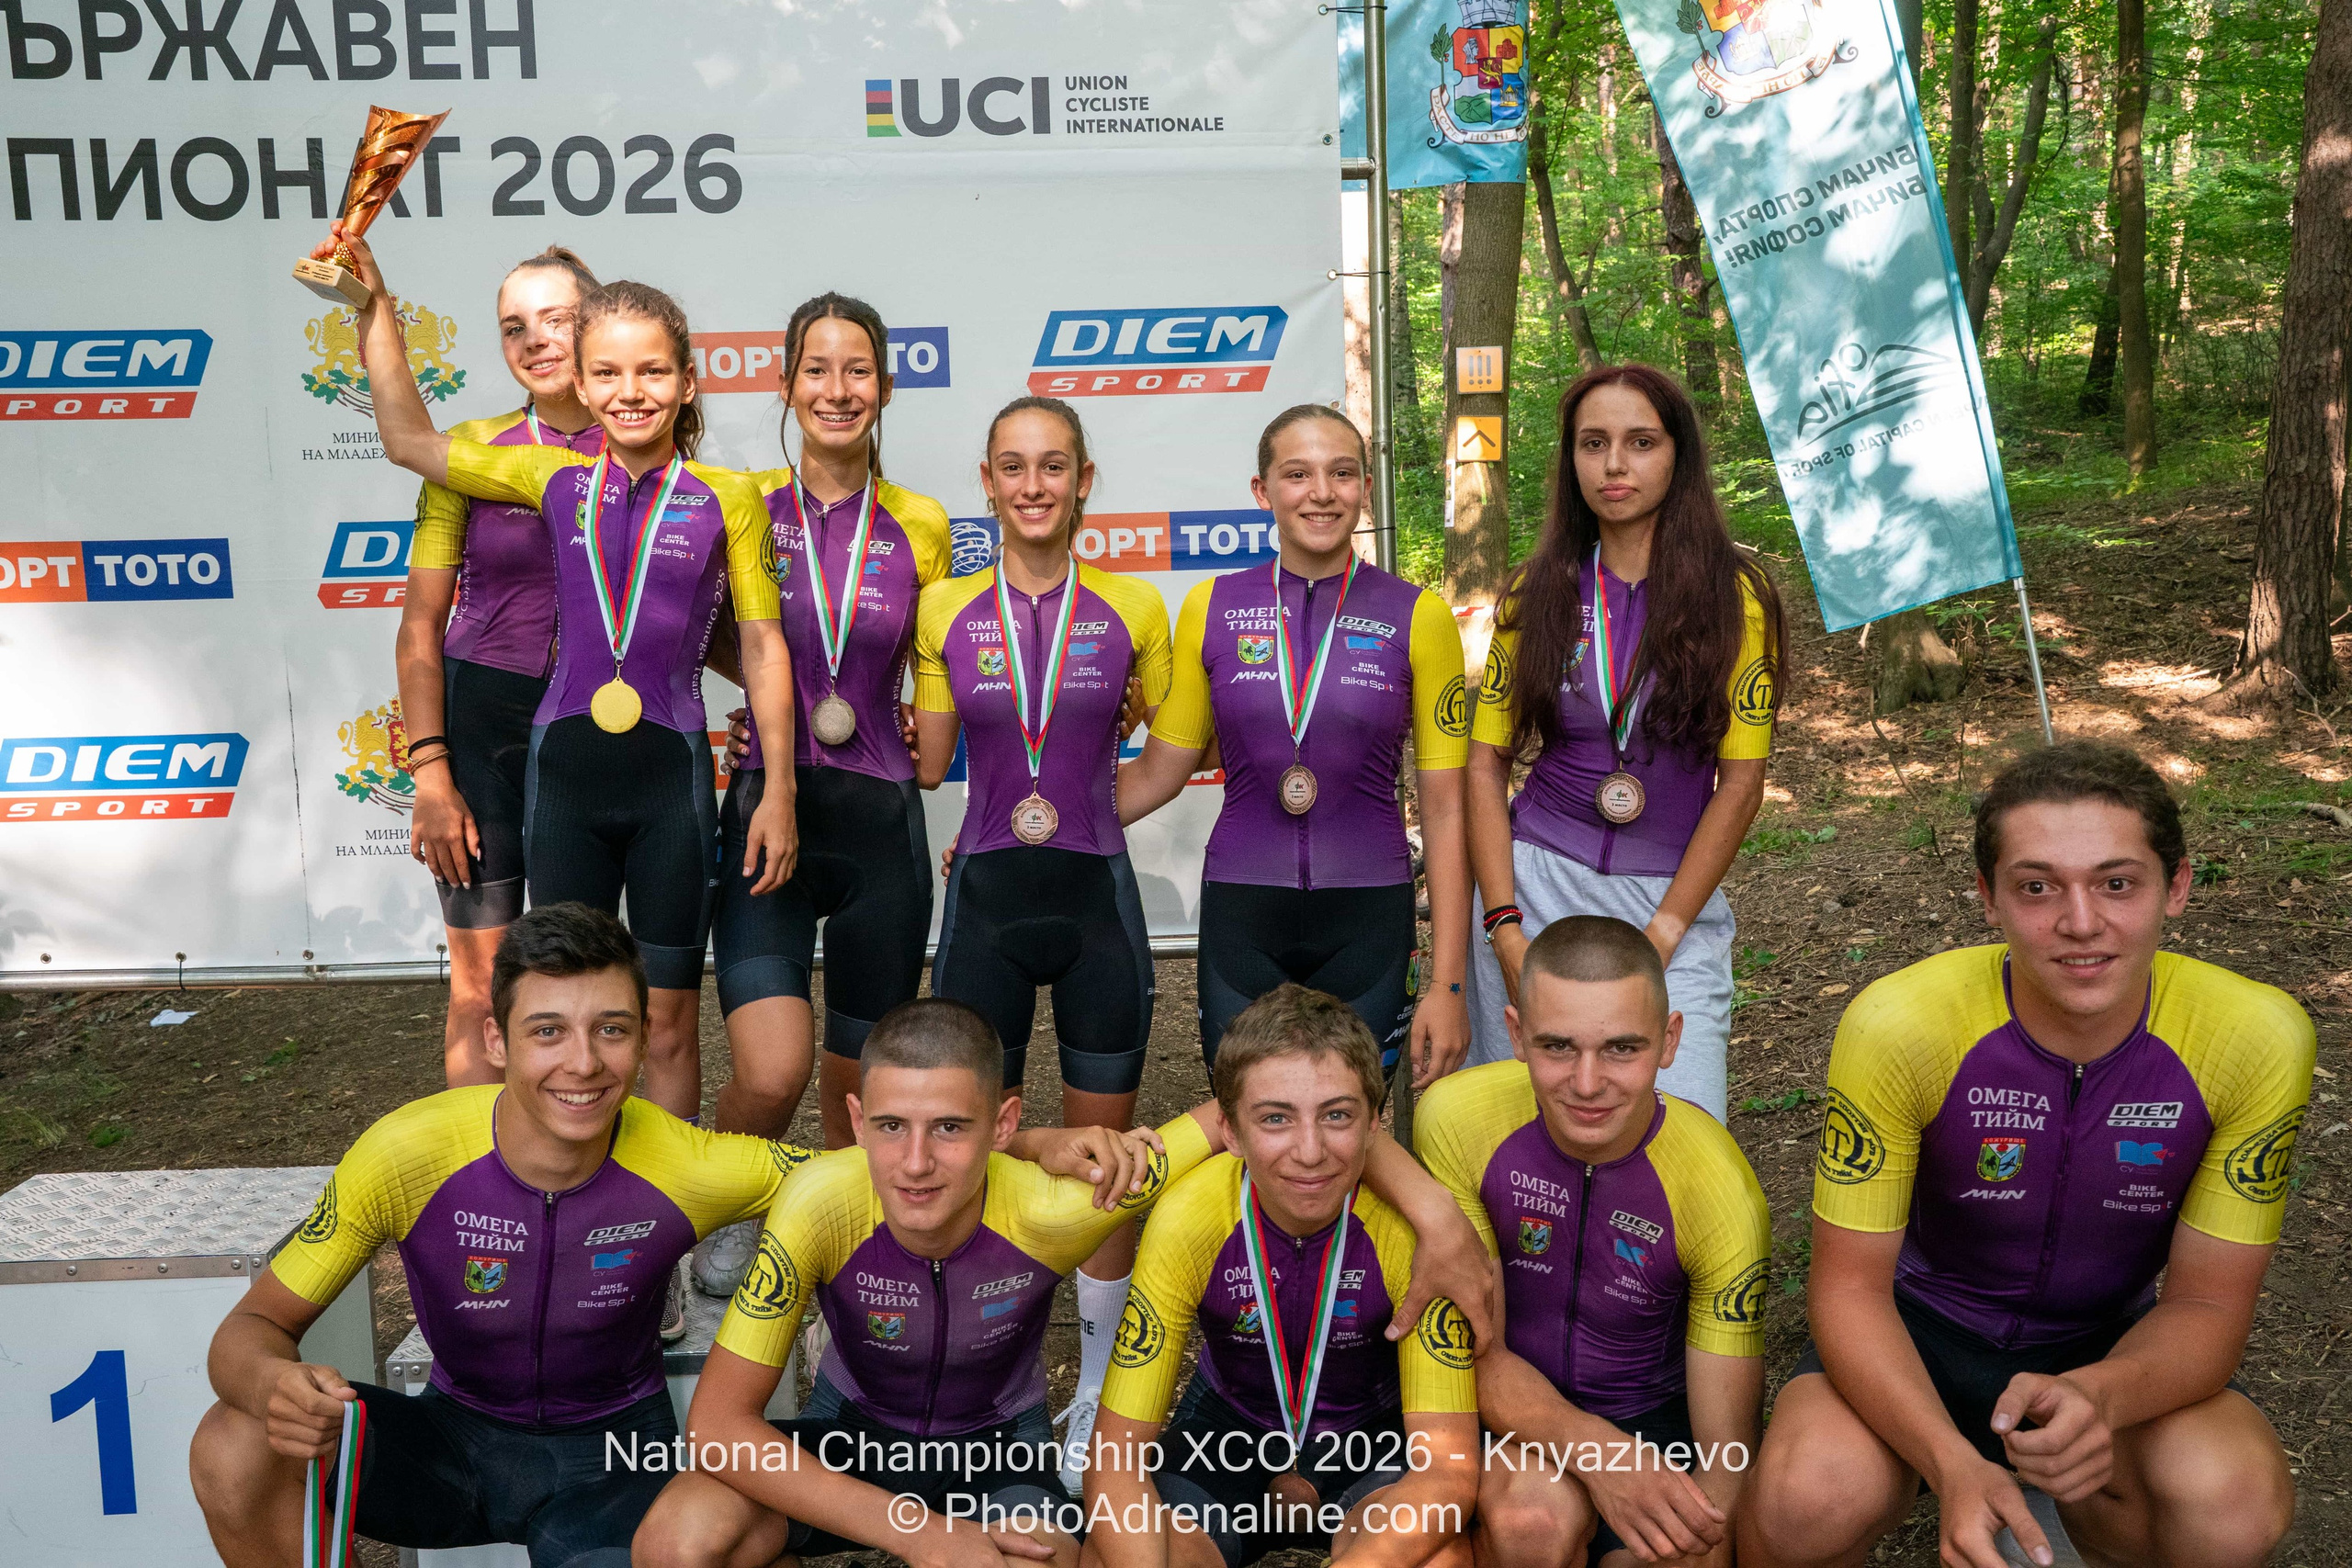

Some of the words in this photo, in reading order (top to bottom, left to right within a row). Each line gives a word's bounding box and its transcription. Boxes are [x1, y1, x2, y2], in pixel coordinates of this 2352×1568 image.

[1064, 74, 1128, 91] UNION
[900, 77, 1052, 137] UCI
[1065, 96, 1149, 113] CYCLISTE
[1065, 117, 1225, 134] INTERNATIONALE
[491, 133, 743, 217] 2026
[1049, 314, 1270, 357] DIEM
[887, 342, 939, 374] ТО
[1047, 371, 1250, 394] SPORT
[302, 448, 322, 461] НА
[94, 553, 221, 587] ТОТО
[697, 607, 718, 660] Omega
[967, 620, 1022, 630] ОМЕА
[1341, 617, 1393, 632] DIEM
[1351, 666, 1385, 676] CENTER
[1359, 661, 1380, 671] BIKE
[691, 664, 703, 700] Team
[1340, 676, 1368, 687] Bike
[6, 741, 231, 784] DIEM
[6, 797, 215, 818] SPORT
[335, 846, 357, 856] НА
[360, 844, 410, 856] МЛАДЕ
[1968, 1087, 2052, 1111] ОМЕГА
[1970, 1108, 2046, 1131] ТИЙМ
[2114, 1104, 2178, 1117] DIEM
[1510, 1170, 1571, 1203] ОМЕГА
[2119, 1190, 2165, 1198] CENTER
[2130, 1184, 2157, 1192] BIKE
[1512, 1190, 1567, 1218] ТИЙМ
[2102, 1200, 2138, 1212] Bike
[454, 1211, 529, 1236] ОМЕГА
[591, 1222, 652, 1238] DIEM
[1613, 1213, 1661, 1236] DIEM
[457, 1231, 526, 1252] ТИЙМ
[591, 1286, 629, 1295] CENTER
[599, 1282, 624, 1291] BIKE
[856, 1271, 921, 1293] ОМЕГА
[978, 1273, 1031, 1293] DIEM
[857, 1290, 919, 1306] ТИЙМ
[1604, 1286, 1630, 1301] Bike
[51, 1349, 137, 1516] 1
